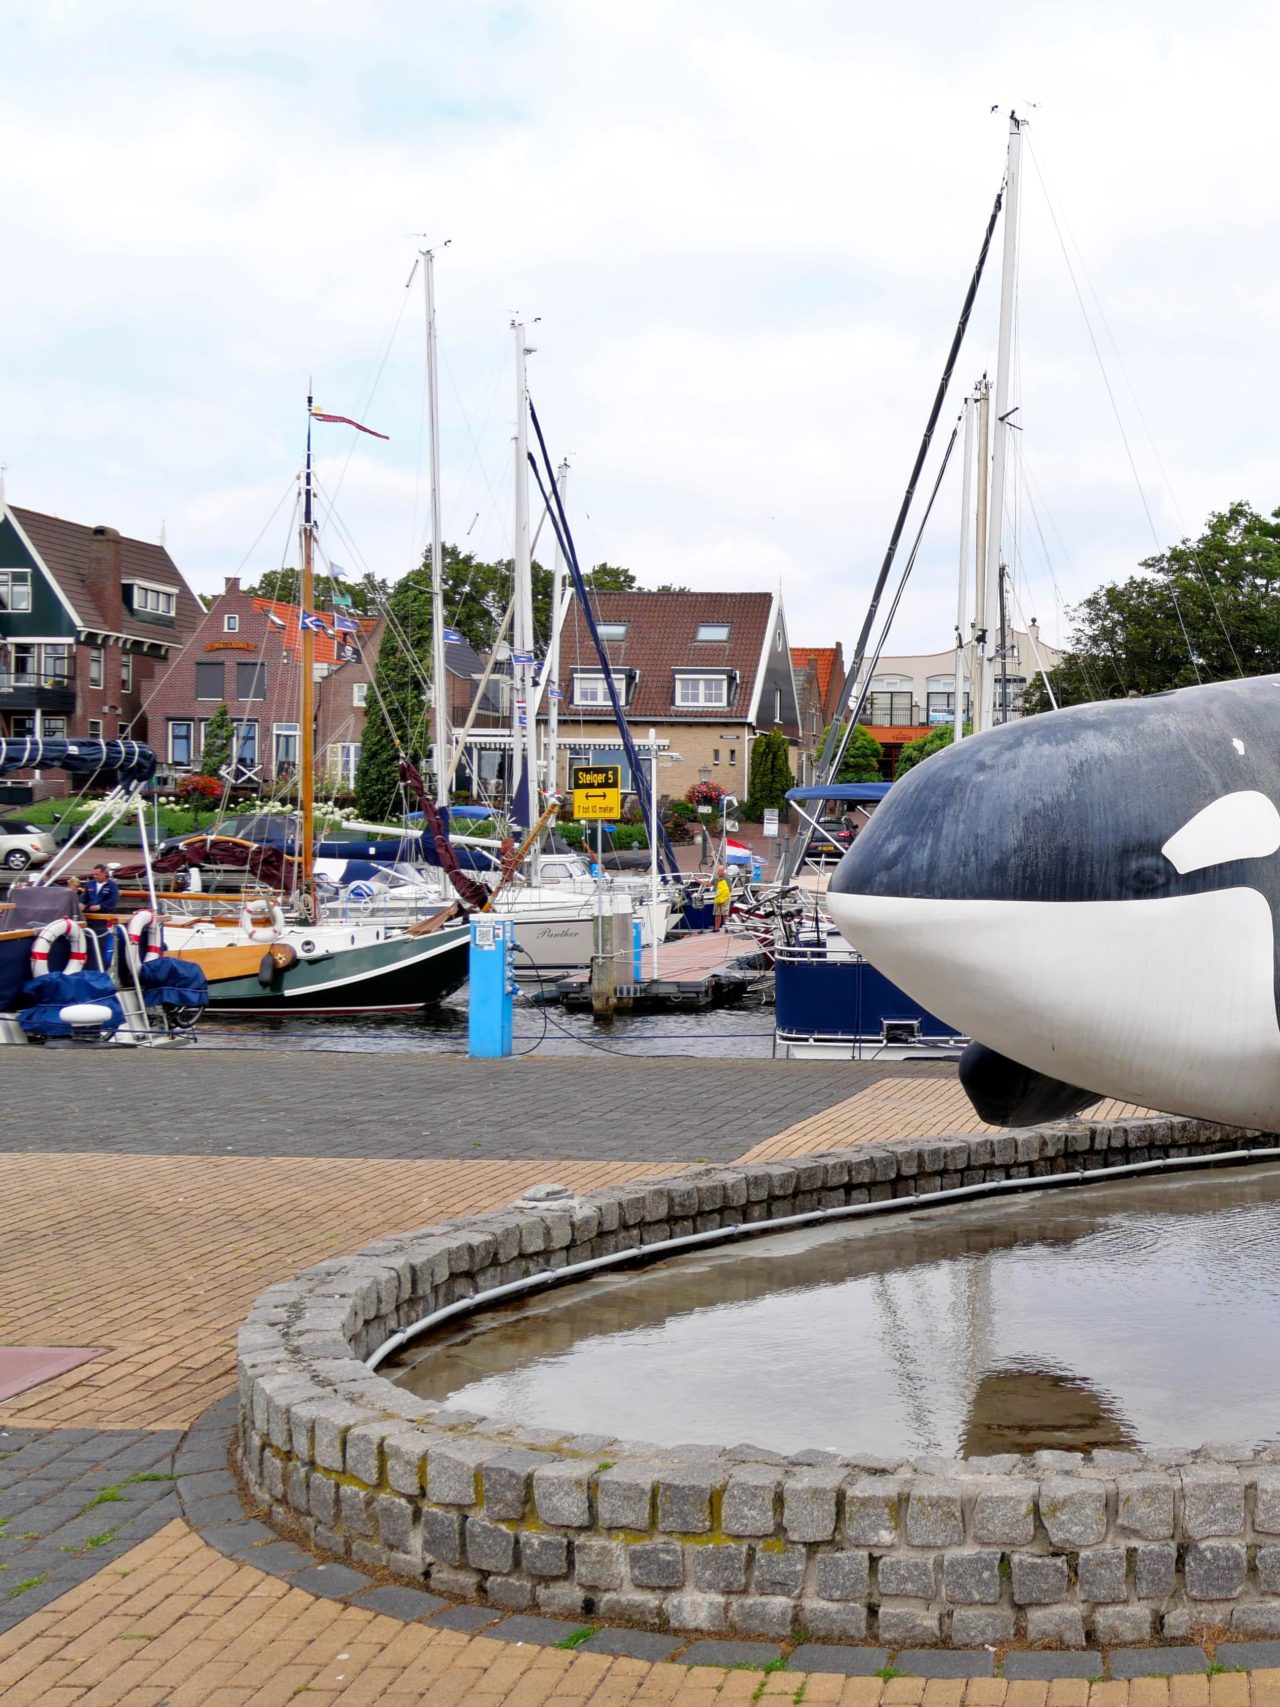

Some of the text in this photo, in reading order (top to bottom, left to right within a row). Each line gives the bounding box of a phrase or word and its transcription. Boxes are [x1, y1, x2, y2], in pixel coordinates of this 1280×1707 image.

[578, 771, 614, 787] Steiger 5
[582, 805, 590, 813] tot
[598, 805, 615, 813] meter
[536, 927, 579, 939] Panther
